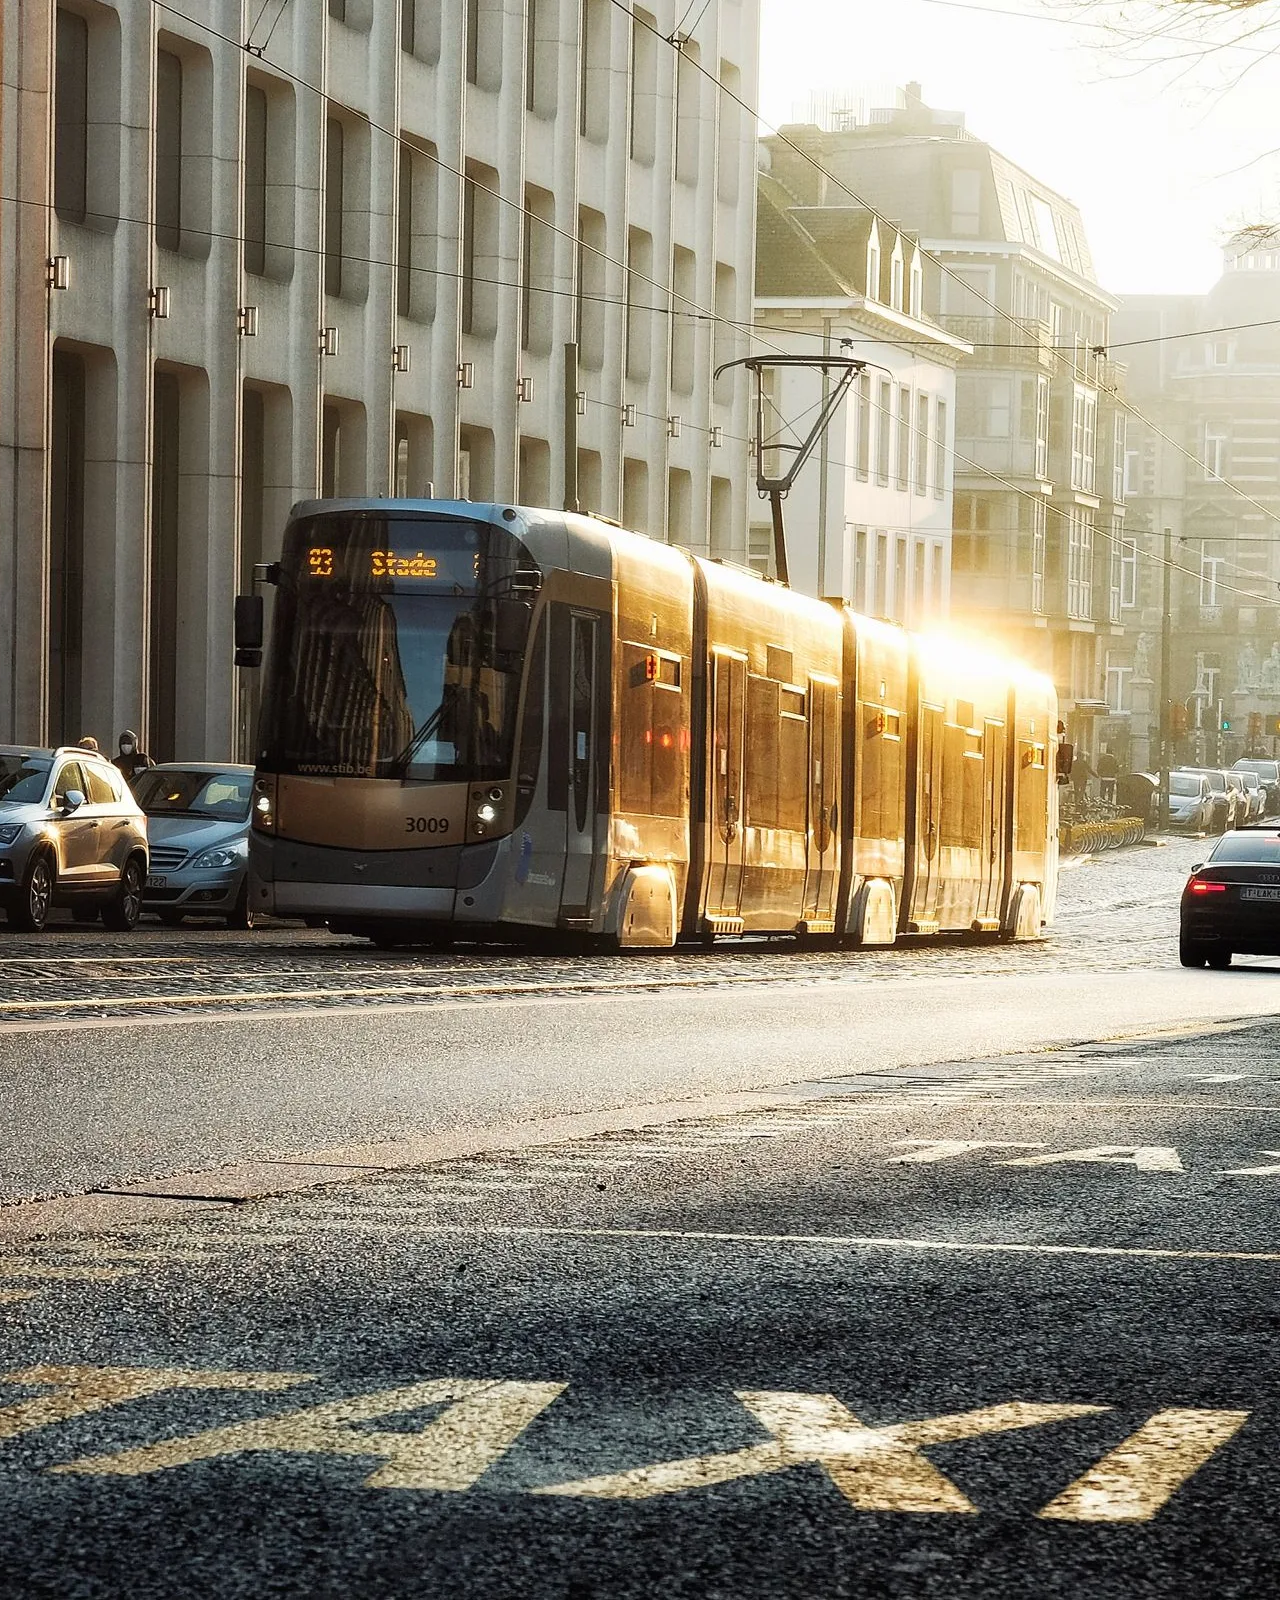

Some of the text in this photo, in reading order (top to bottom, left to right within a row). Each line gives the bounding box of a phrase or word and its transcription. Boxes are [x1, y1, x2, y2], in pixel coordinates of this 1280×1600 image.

[370, 550, 437, 577] Stade
[297, 763, 372, 775] www.stib.be
[405, 817, 449, 833] 3009
